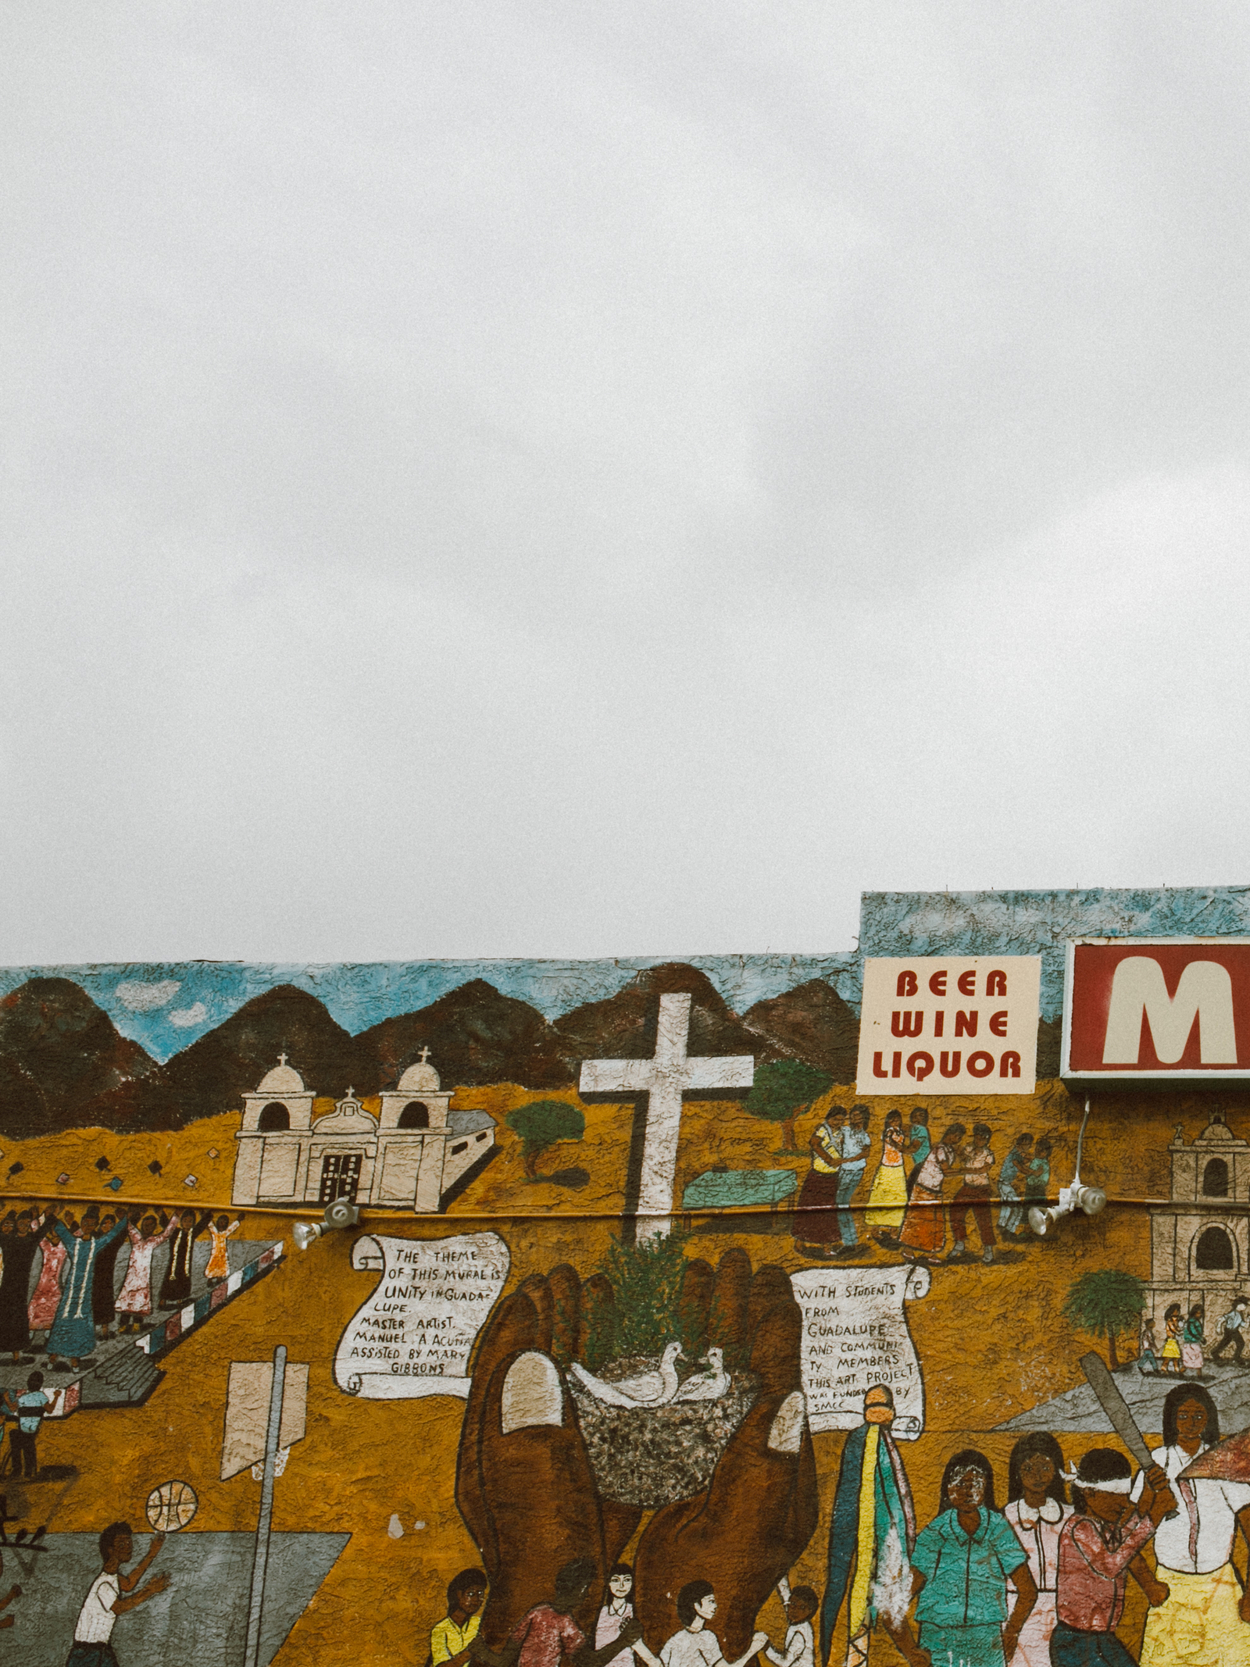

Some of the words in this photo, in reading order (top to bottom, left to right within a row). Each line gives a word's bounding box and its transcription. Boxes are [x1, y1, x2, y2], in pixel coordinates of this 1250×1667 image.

[896, 969, 1007, 997] BEER
[891, 1010, 1008, 1038] WINE
[873, 1050, 1021, 1082] LIQUOR
[396, 1250, 419, 1264] THE
[434, 1251, 477, 1262] THEME
[388, 1269, 404, 1280] OF
[412, 1269, 438, 1280] THIS
[444, 1270, 487, 1280] MURAL
[491, 1269, 500, 1280] IS
[385, 1285, 426, 1300] UNITY
[799, 1286, 836, 1299] WITH
[846, 1283, 896, 1298] STUDENTS
[805, 1306, 840, 1318] FROM
[360, 1317, 405, 1329] MASTER
[808, 1323, 886, 1337] GUADALUPE
[353, 1332, 407, 1344] MANUEL
[350, 1347, 399, 1359] ASSISTED
[409, 1349, 421, 1359] BY
[427, 1350, 466, 1361] MARY
[810, 1342, 832, 1355] AND
[391, 1363, 445, 1375] GIBBONS
[810, 1361, 821, 1372] TY
[837, 1355, 899, 1369] MEMBERS
[808, 1379, 830, 1388] THIS
[836, 1374, 856, 1386] ART
[866, 1363, 914, 1384] PROJECT
[896, 1387, 910, 1398] BY
